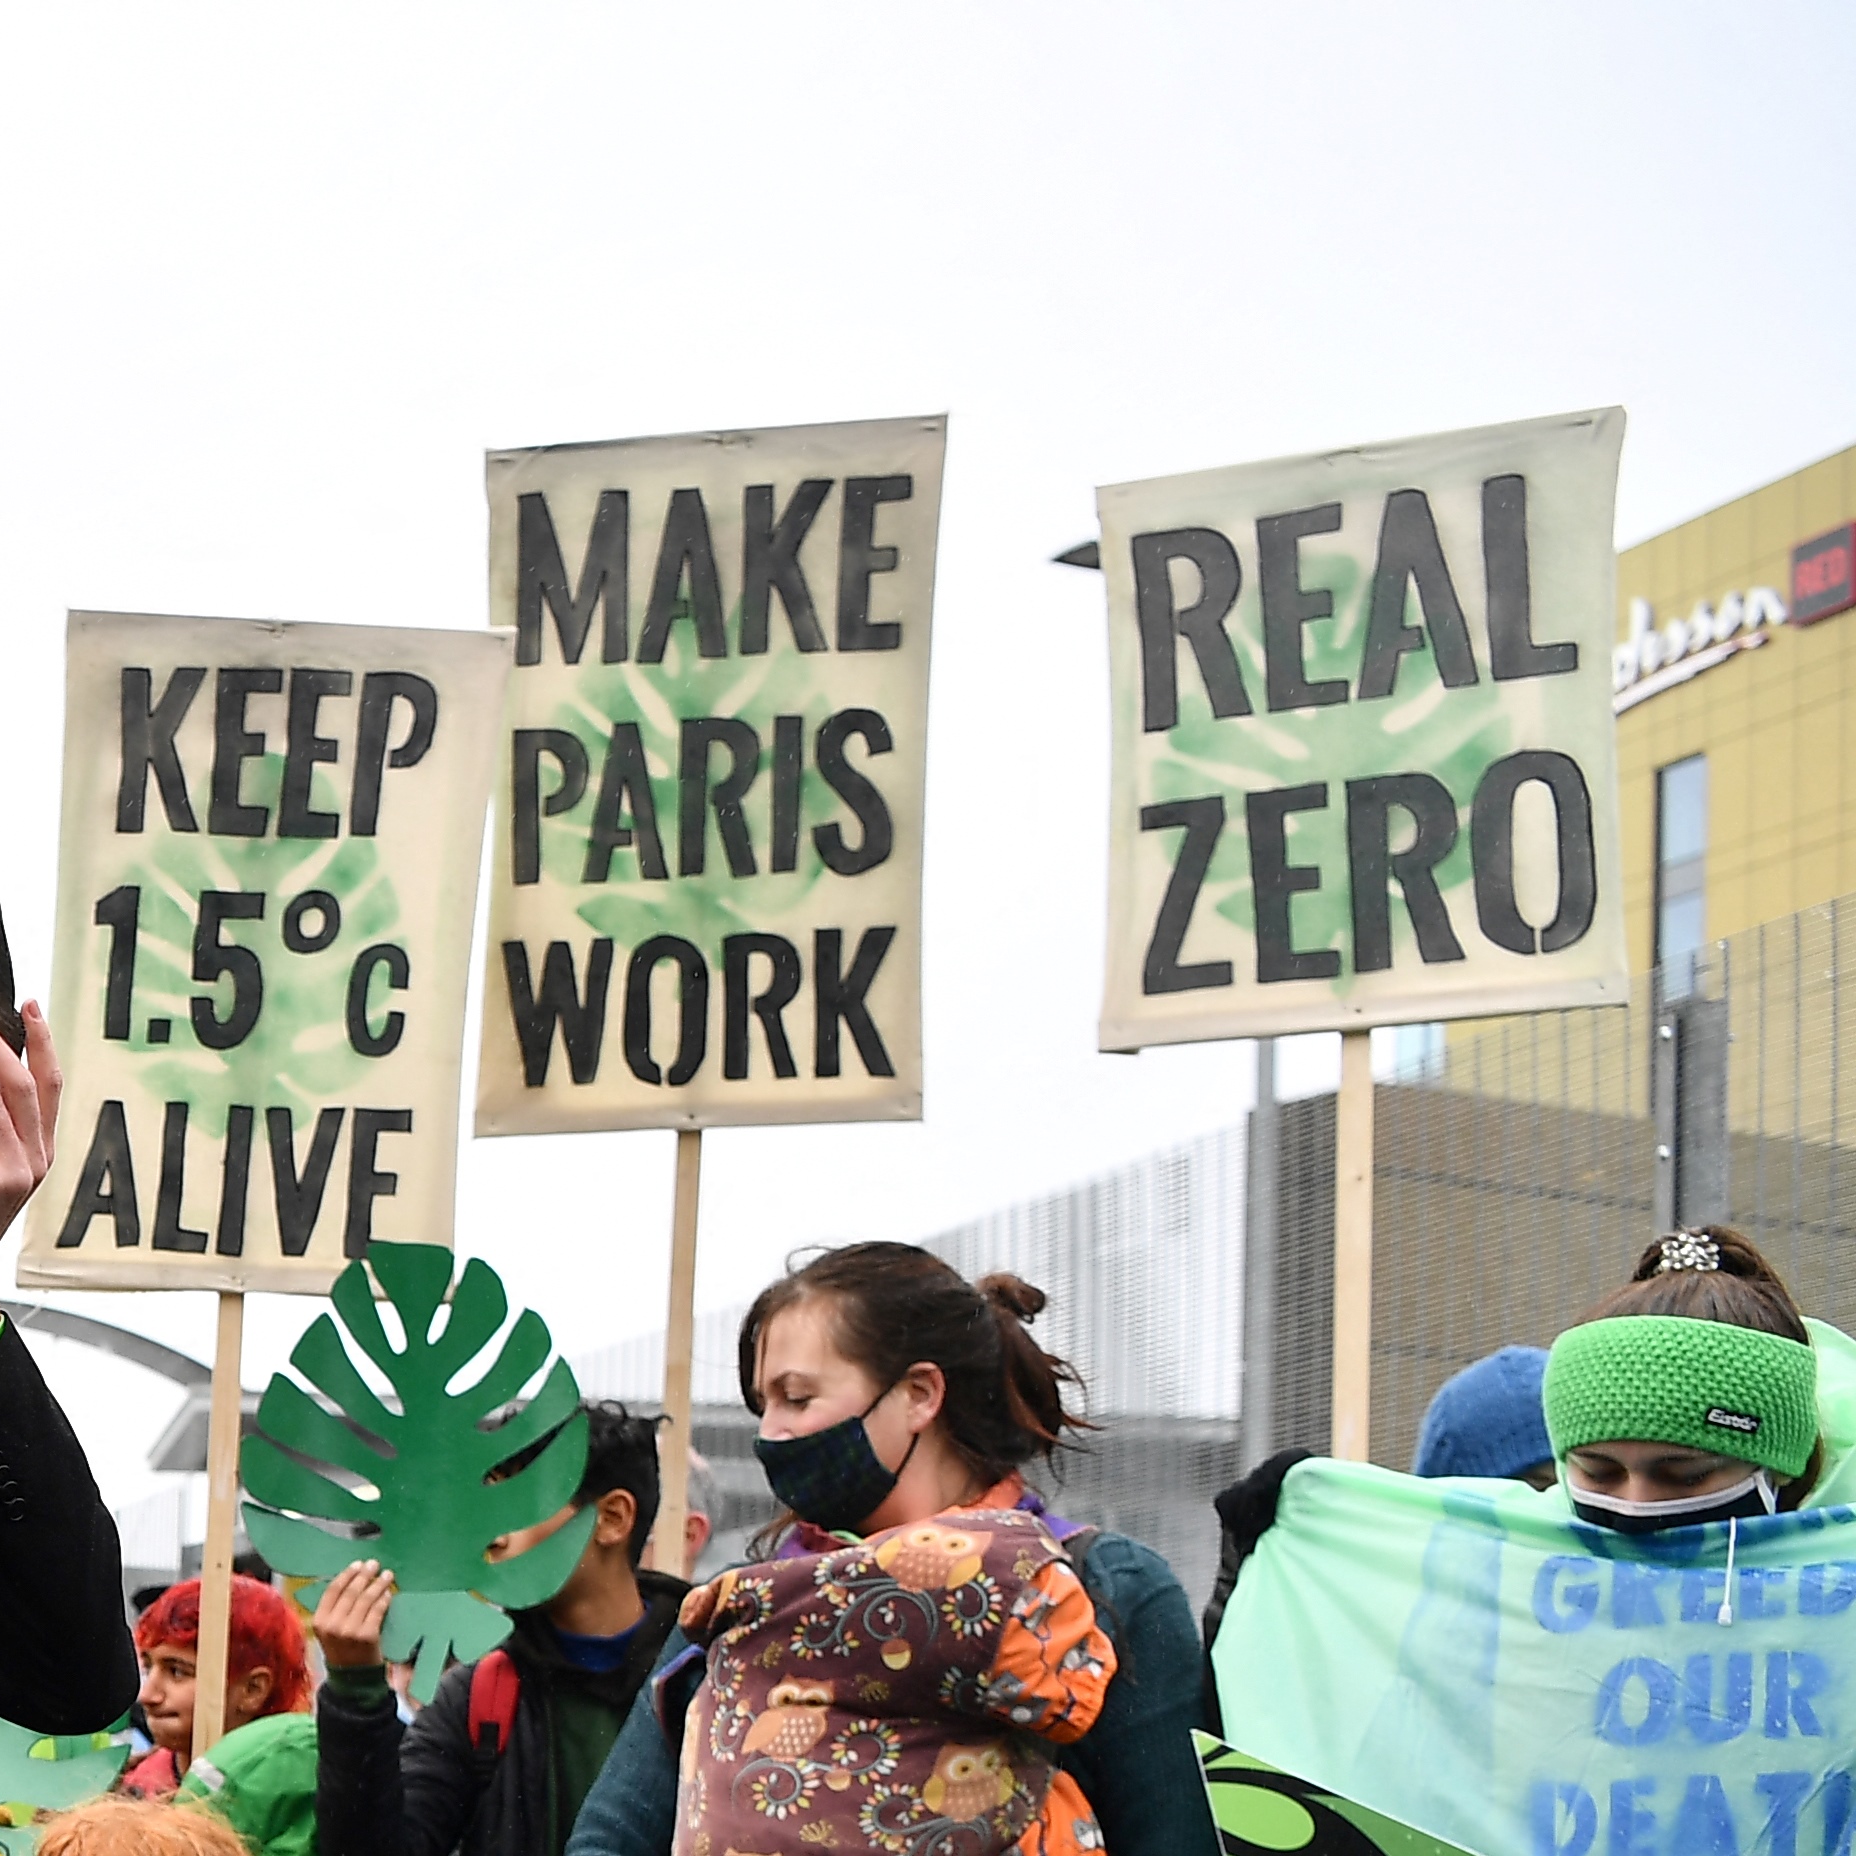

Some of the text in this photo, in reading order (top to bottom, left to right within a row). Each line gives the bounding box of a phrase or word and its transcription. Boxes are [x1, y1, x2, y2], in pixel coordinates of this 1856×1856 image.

[513, 475, 913, 666] MAKE
[1131, 473, 1578, 733] REAL
[115, 667, 439, 838] KEEP
[512, 708, 895, 885] PARIS
[1139, 749, 1596, 996] ZERO
[503, 926, 898, 1088] WORK
[55, 1099, 413, 1260] ALIVE
[1595, 1651, 1833, 1748] OUR
